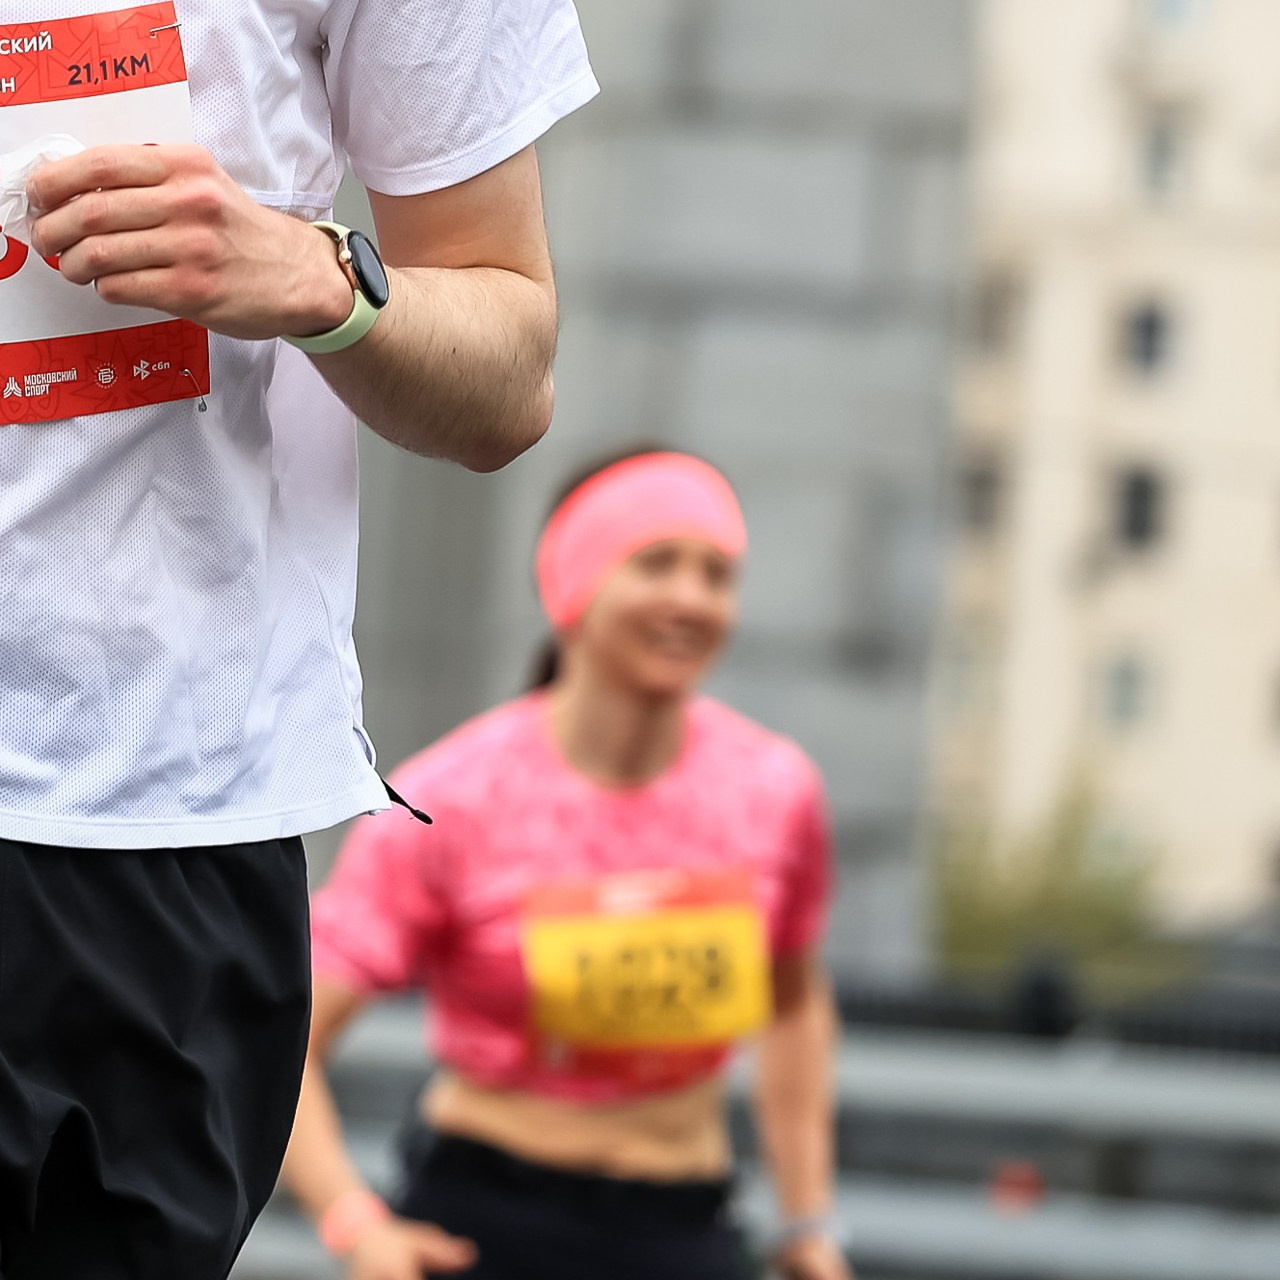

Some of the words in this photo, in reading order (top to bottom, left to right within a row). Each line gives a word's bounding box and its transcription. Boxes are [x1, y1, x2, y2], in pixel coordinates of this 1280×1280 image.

[68, 60, 109, 85] 21,1
[24, 368, 77, 386] МОСКОВСКИЙ
[25, 384, 50, 397] СПОРТ
